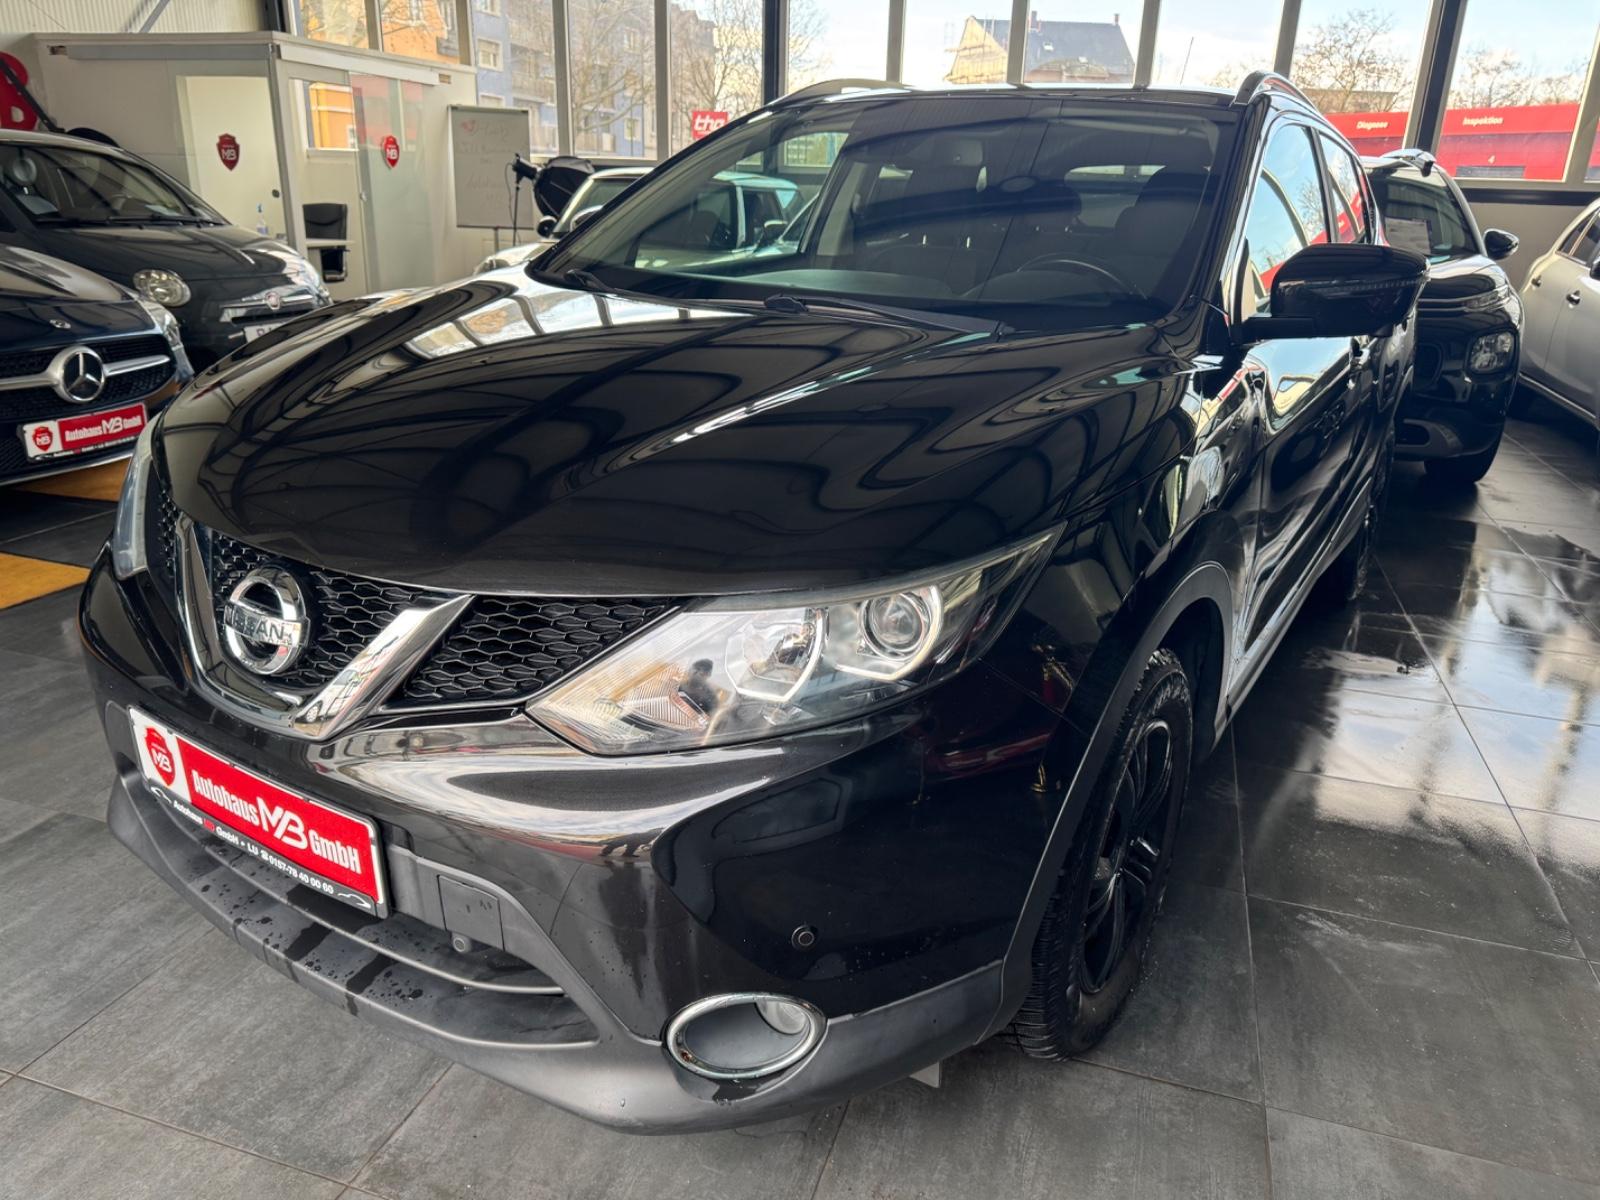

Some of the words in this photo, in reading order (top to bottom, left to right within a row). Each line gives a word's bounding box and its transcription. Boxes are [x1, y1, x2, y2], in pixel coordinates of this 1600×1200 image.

[1462, 116, 1504, 127] Inspektion
[64, 427, 103, 442] Autohaus
[101, 417, 123, 434] MB
[151, 749, 172, 772] MB
[191, 769, 260, 827] Autohaus
[256, 796, 308, 850] MB
[308, 829, 362, 875] GmbH
[216, 826, 239, 846] GmbH
